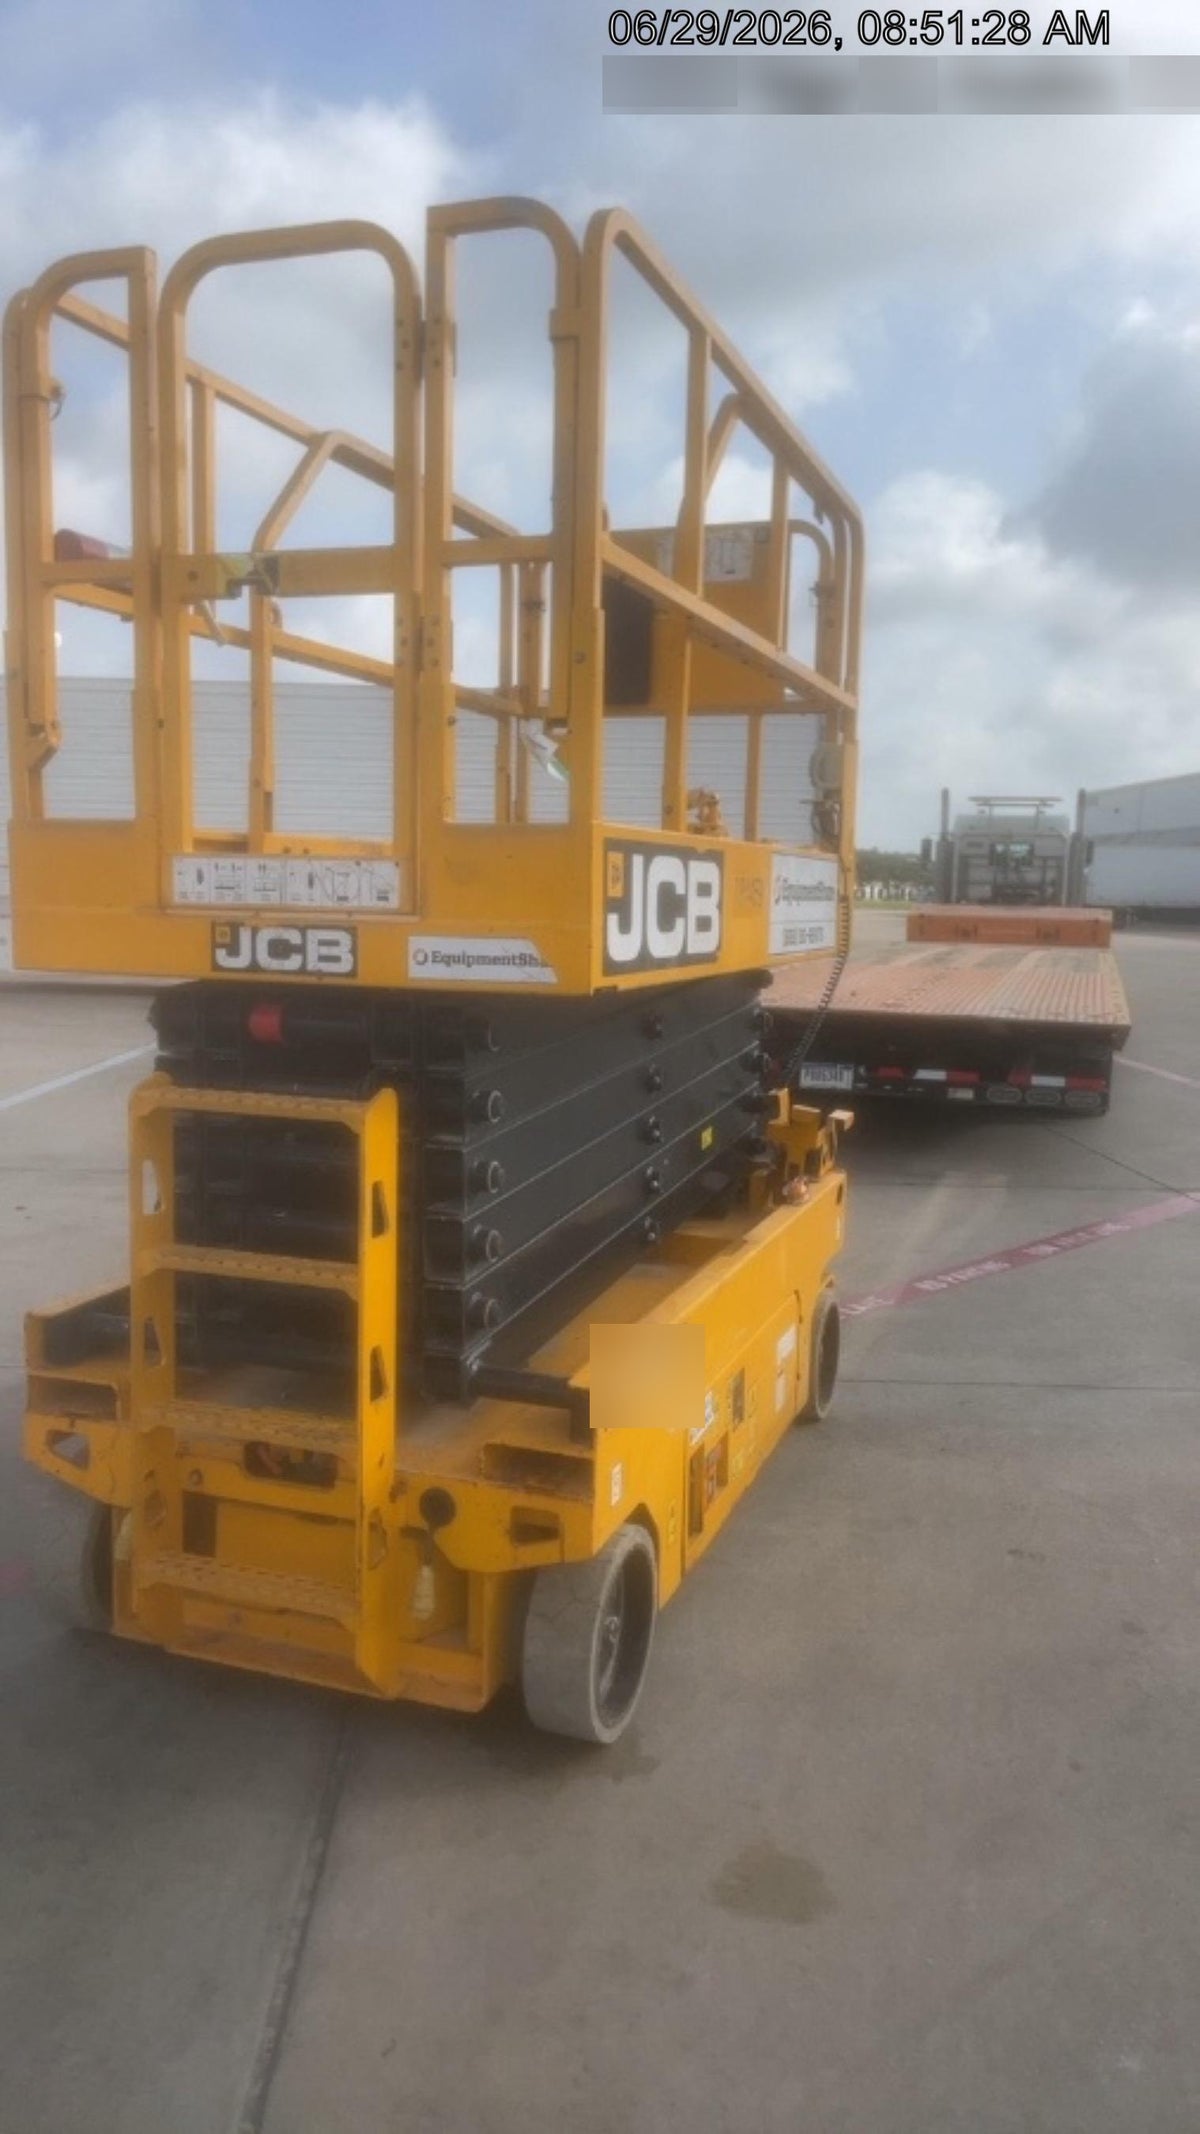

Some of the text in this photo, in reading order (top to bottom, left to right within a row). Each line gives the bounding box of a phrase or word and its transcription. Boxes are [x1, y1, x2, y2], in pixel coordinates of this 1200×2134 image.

[606, 852, 721, 962] JCB
[215, 926, 354, 973] JCB
[431, 949, 553, 968] EquipmentSh
